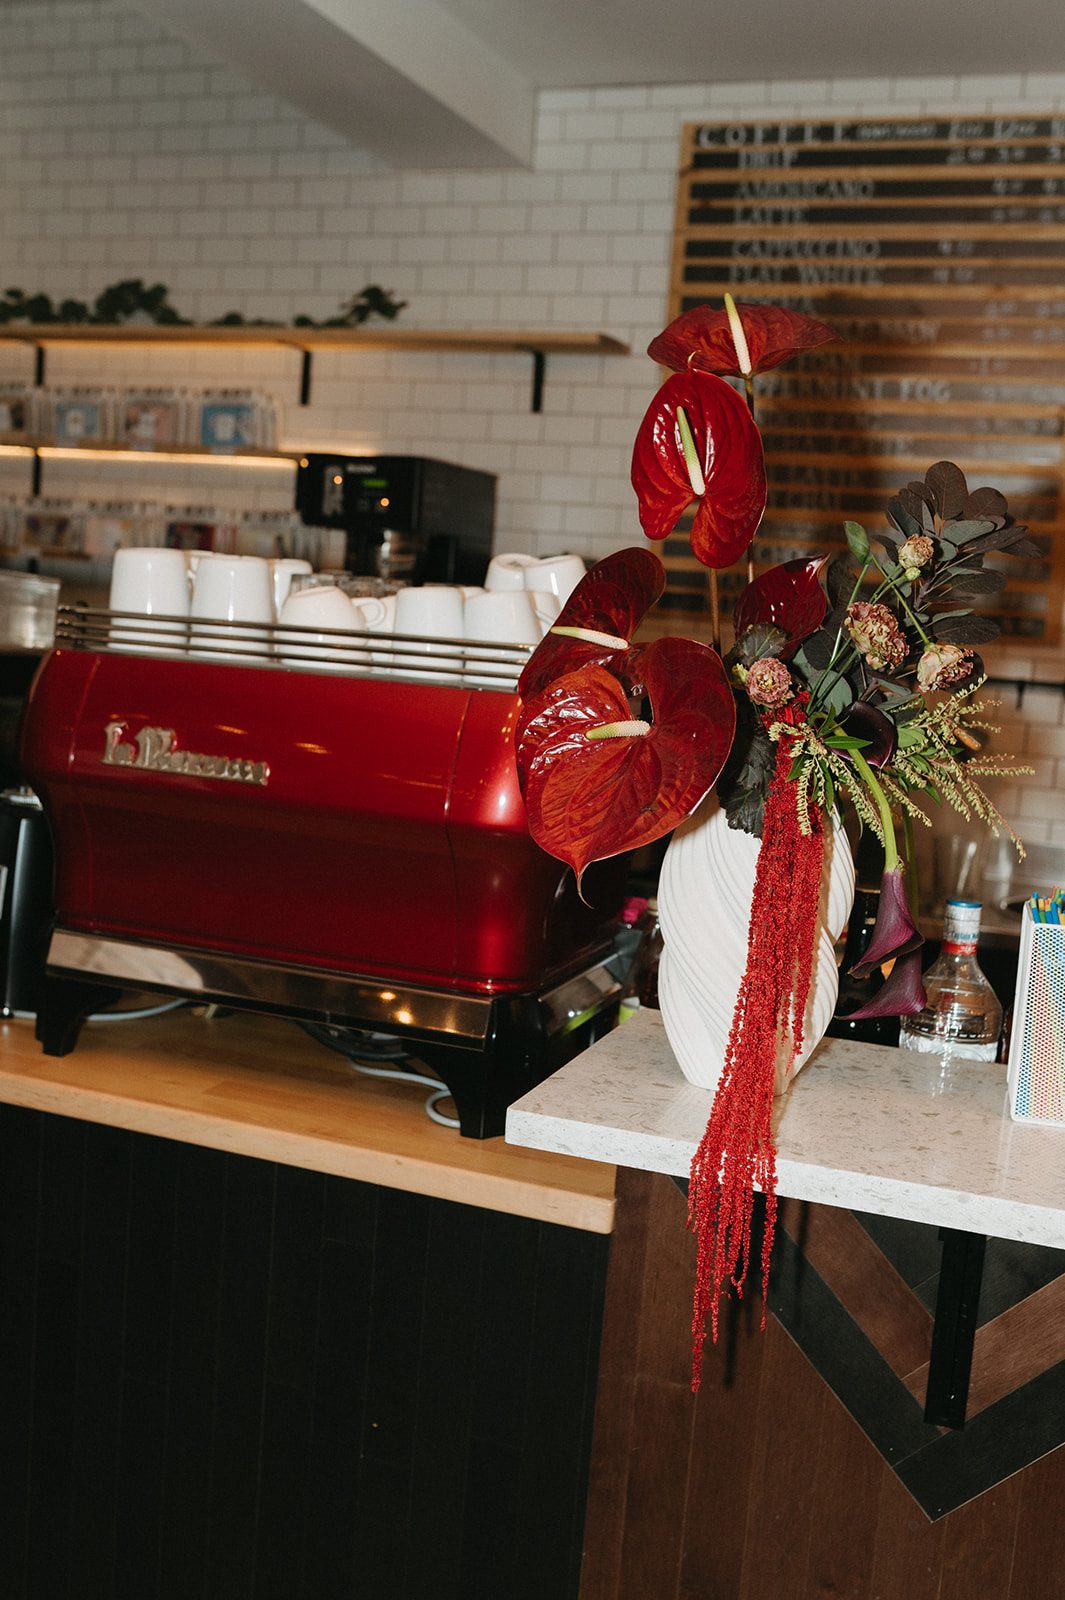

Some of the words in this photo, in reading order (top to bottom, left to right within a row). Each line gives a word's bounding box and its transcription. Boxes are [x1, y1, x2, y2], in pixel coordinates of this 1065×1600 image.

[735, 179, 875, 199] AMERICANO
[732, 205, 810, 226] LATTE
[731, 237, 881, 260] CAPPUCCINO
[728, 265, 783, 284] FLAT
[797, 264, 884, 286] WHITE
